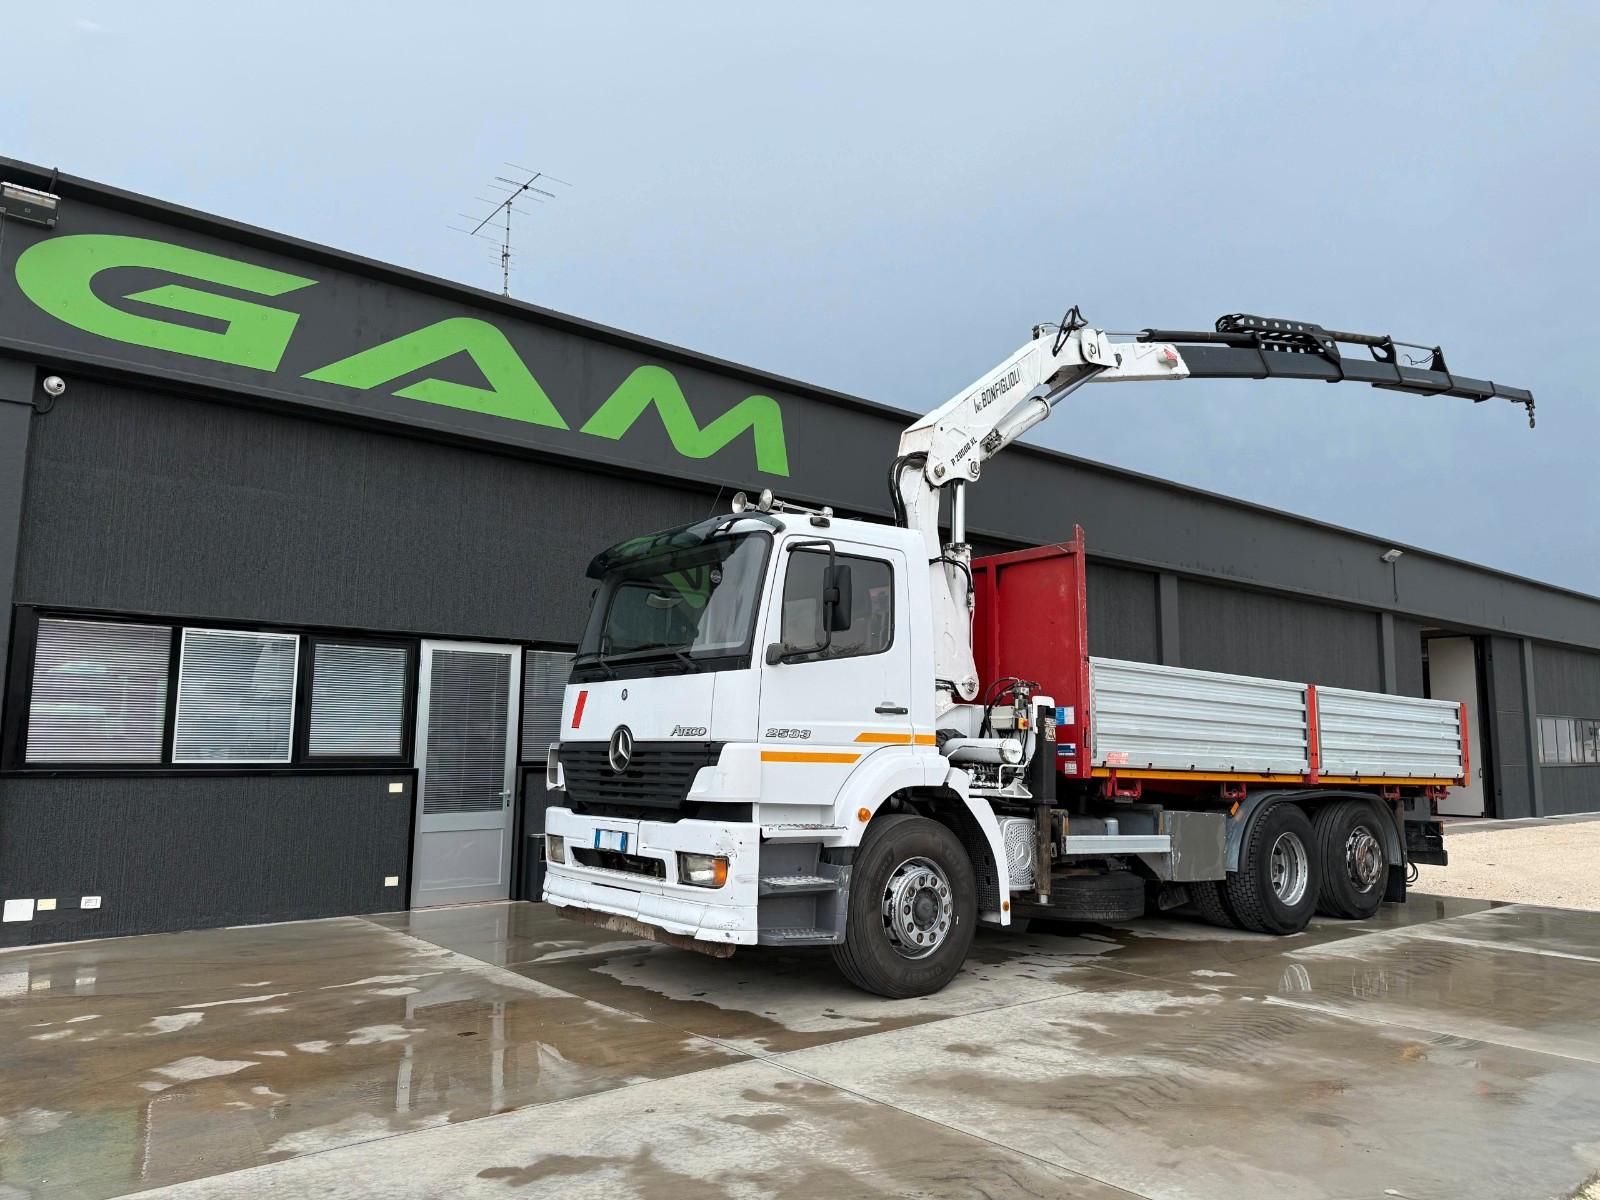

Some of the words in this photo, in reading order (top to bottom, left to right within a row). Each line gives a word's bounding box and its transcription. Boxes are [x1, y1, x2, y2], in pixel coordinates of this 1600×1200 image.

[15, 235, 788, 476] GAM
[981, 367, 1021, 408] BONFIGLIOLI
[970, 436, 978, 447] XL
[765, 727, 812, 740] 2533
